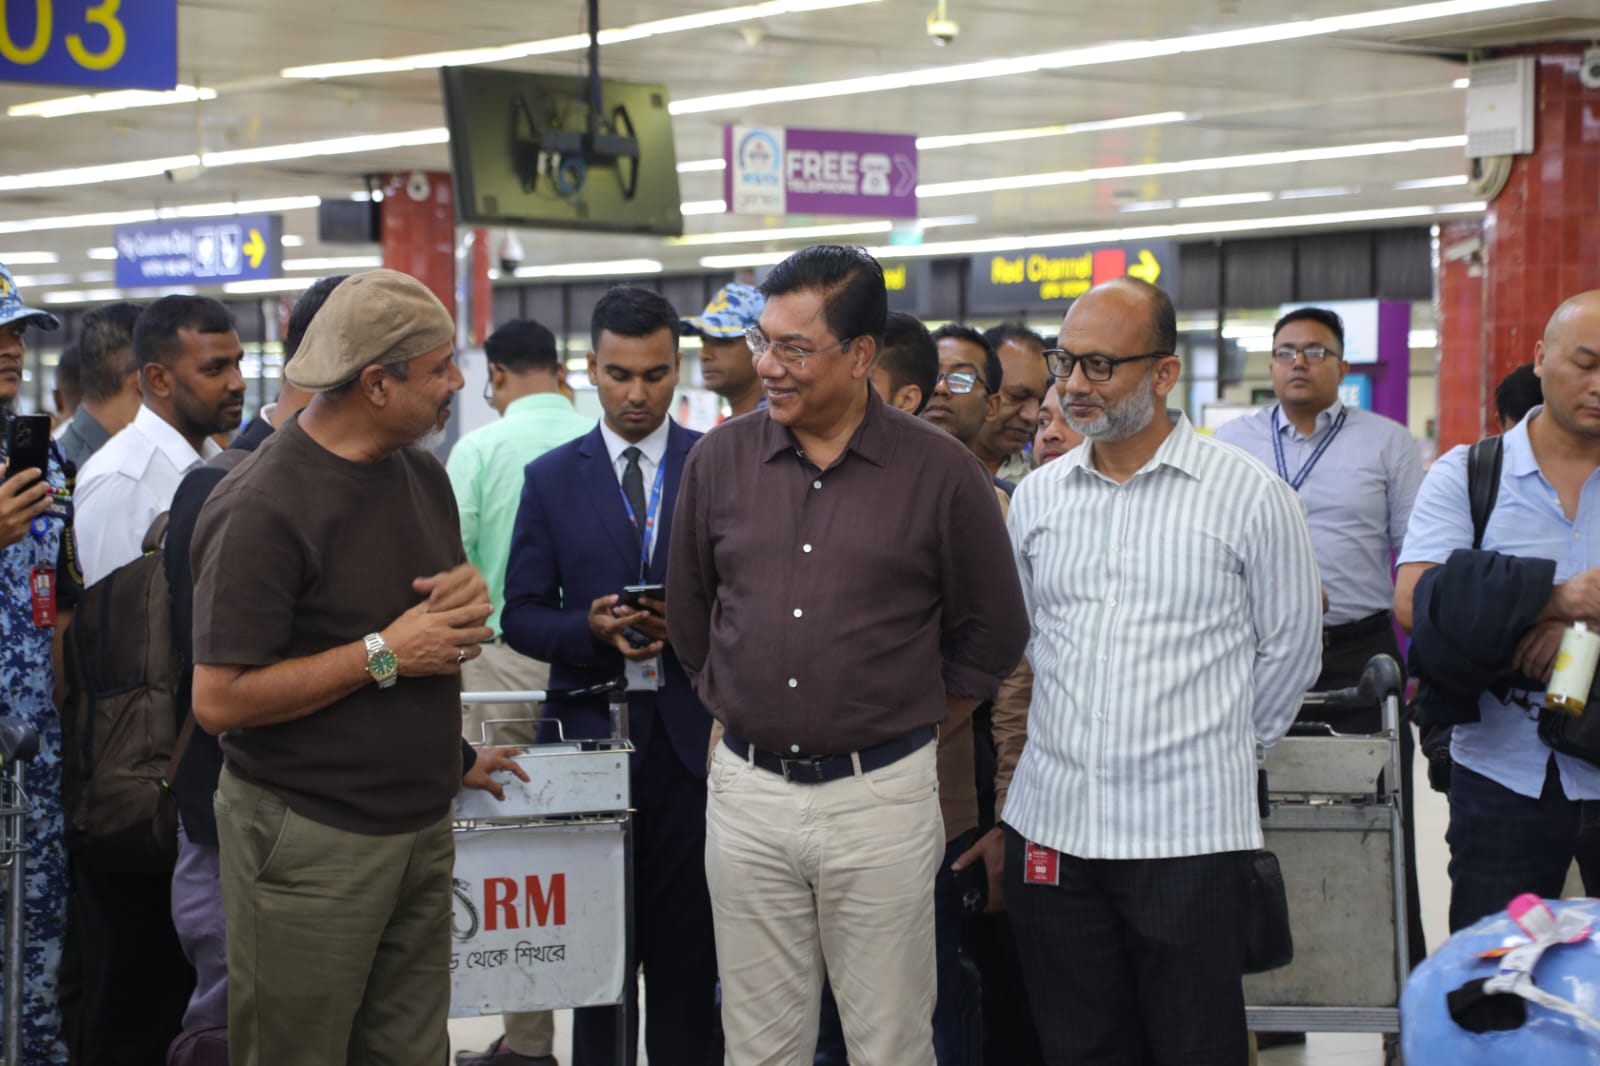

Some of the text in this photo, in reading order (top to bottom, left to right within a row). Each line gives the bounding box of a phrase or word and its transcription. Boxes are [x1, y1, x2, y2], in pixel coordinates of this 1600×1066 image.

[787, 151, 858, 181] FREE
[788, 180, 857, 195] TELEPHONE
[991, 251, 1092, 283] Red Channel
[466, 949, 509, 968] থেকে
[514, 940, 566, 967] শিখরে
